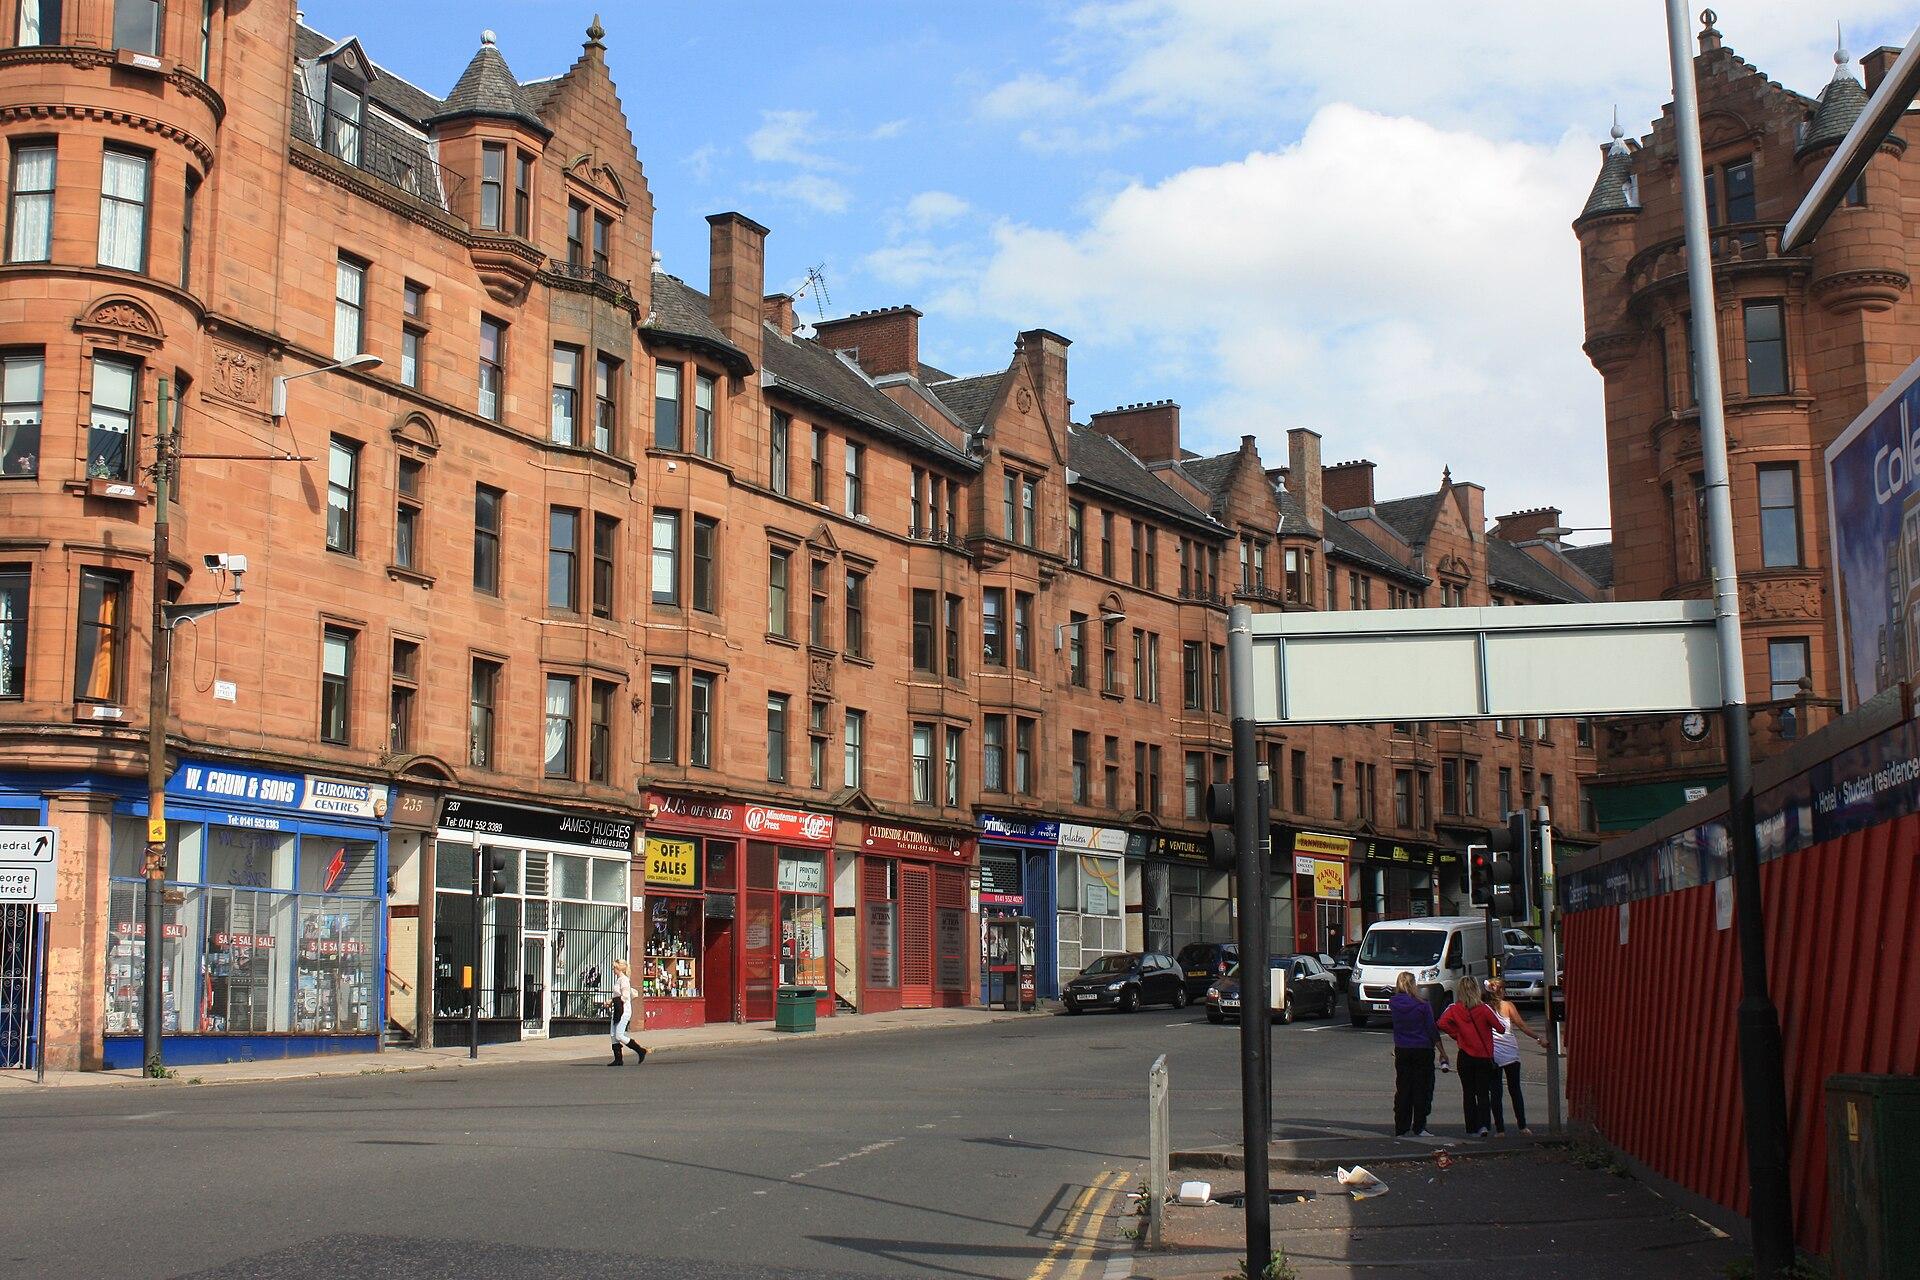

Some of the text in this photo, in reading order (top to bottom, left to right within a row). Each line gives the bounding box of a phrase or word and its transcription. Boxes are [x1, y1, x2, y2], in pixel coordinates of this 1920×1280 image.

[186, 768, 296, 803] W. CRUM & SONS
[316, 782, 366, 800] EURONICS
[1819, 757, 1920, 814] Hotel Student residence
[314, 799, 359, 813] CENTRES
[402, 798, 423, 812] 235
[447, 802, 460, 812] 237
[239, 816, 254, 827] 0141
[254, 819, 266, 827] 552
[766, 809, 798, 823] Minuteman
[458, 818, 474, 829] 0141
[474, 821, 487, 831] 552
[559, 817, 631, 840] JAMES HUGHES
[984, 817, 1027, 836] printing.com
[869, 825, 902, 841] CLYDESIDE
[902, 831, 924, 843] ACTION
[0, 841, 31, 850] edral
[590, 836, 629, 850] hairdressing
[1169, 840, 1195, 852] VENTURE
[661, 844, 680, 857] OFF
[654, 860, 687, 875] SALES
[799, 866, 819, 875] PRINTING
[798, 880, 818, 889] COPYING
[994, 894, 1005, 902] 0141
[258, 937, 275, 947] SALE
